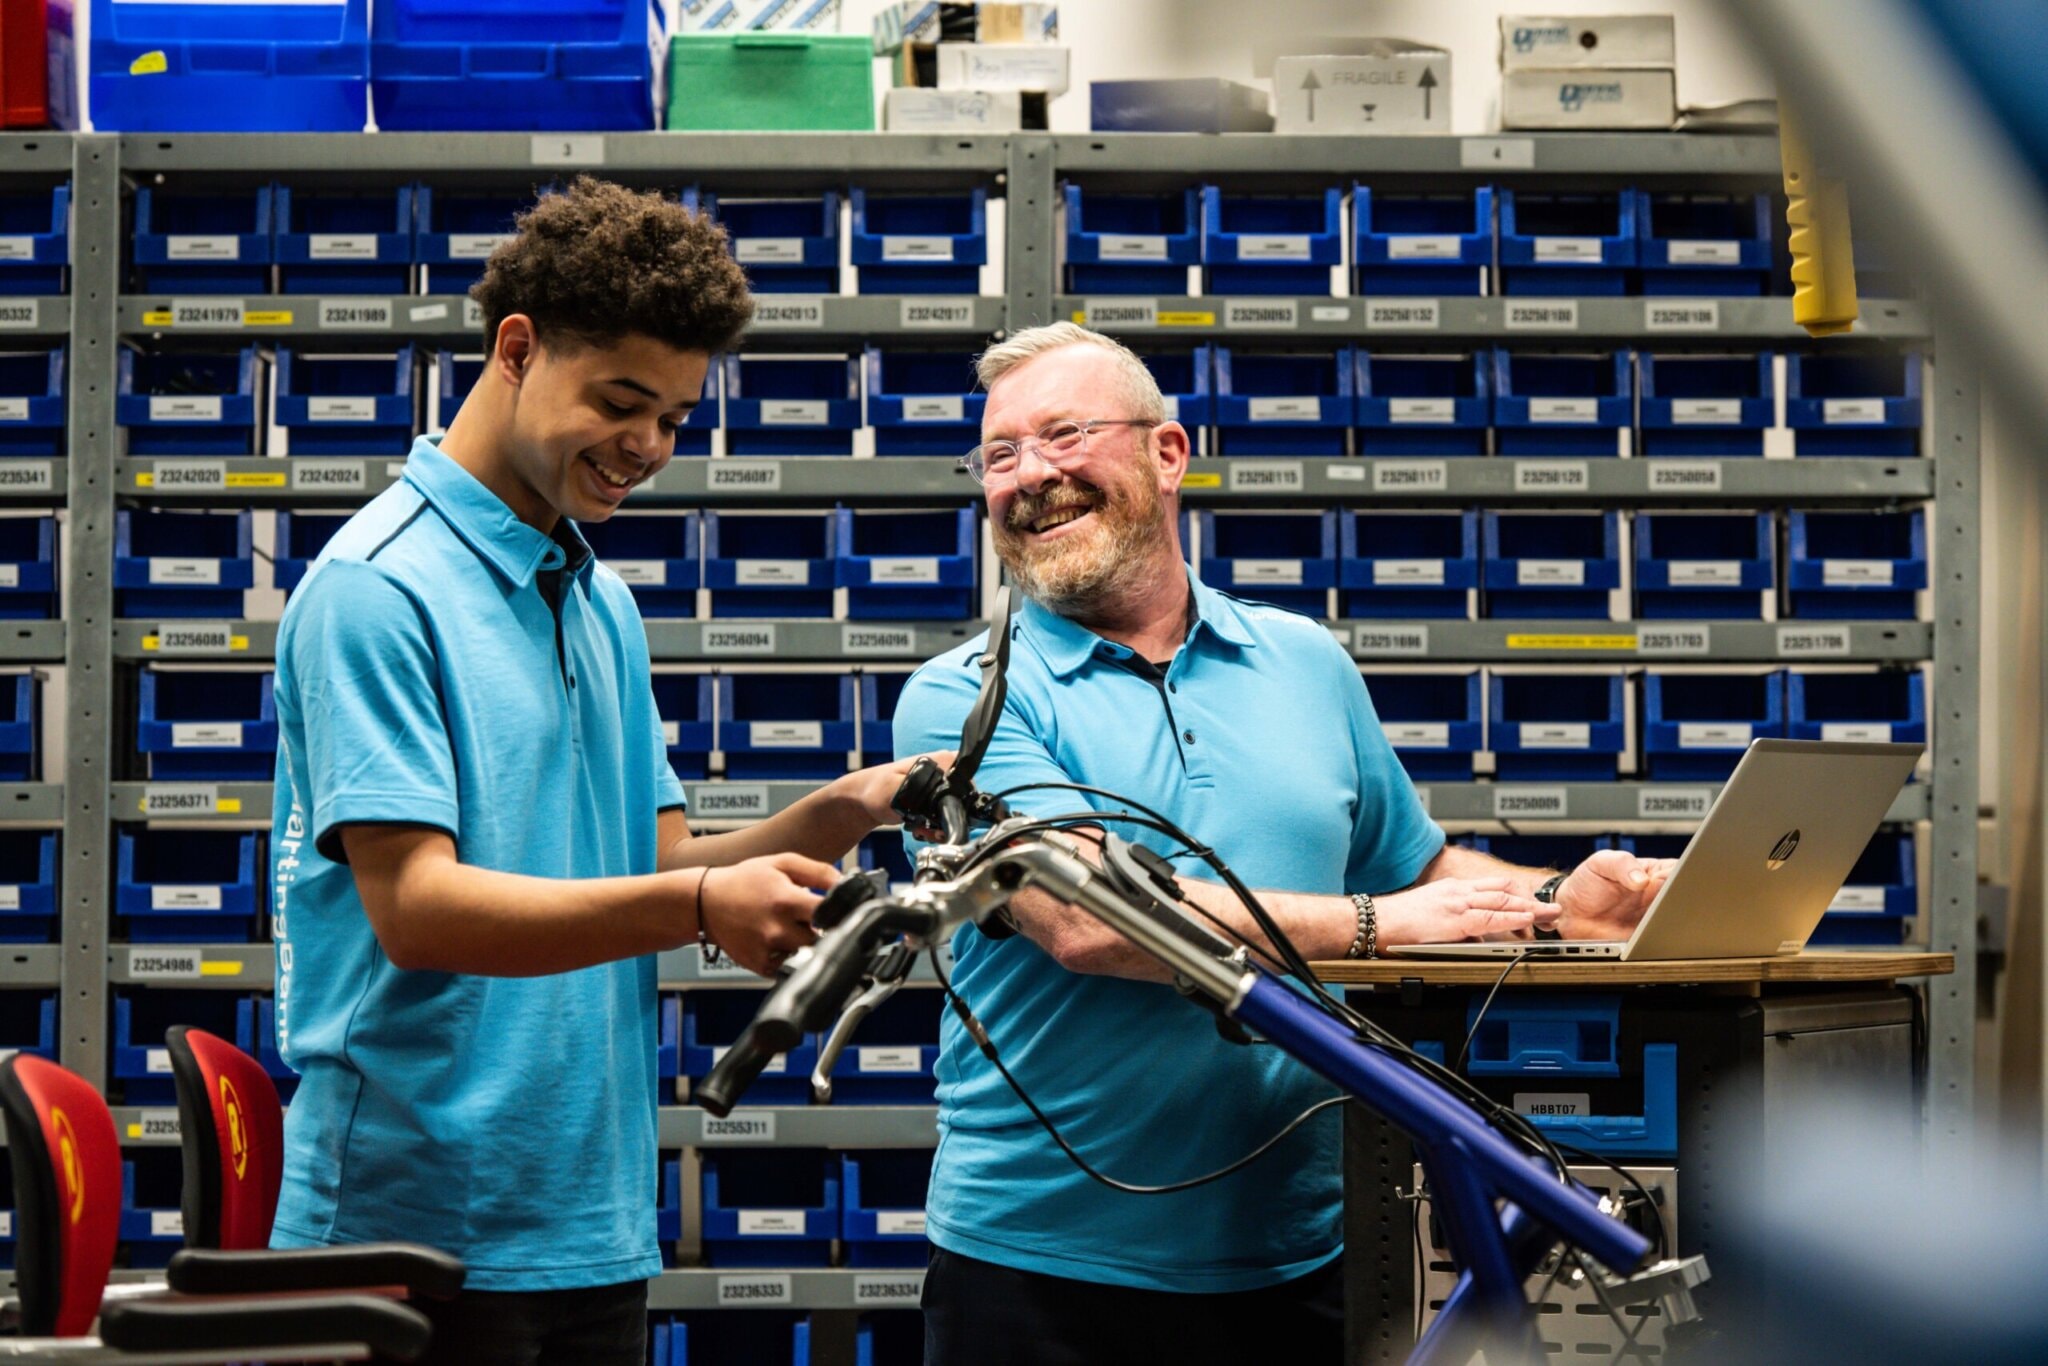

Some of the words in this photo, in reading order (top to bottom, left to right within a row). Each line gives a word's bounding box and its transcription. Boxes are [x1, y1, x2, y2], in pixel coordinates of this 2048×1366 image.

[1331, 71, 1406, 86] FRAGILE
[178, 307, 240, 323] 23241979
[325, 307, 387, 323] 23241989
[159, 468, 221, 484] 23242020
[299, 468, 361, 484] 23242024
[164, 632, 227, 647] 23256088
[708, 632, 770, 647] 23256094
[149, 793, 210, 809] 23256371
[272, 785, 305, 1056] artingBank
[133, 957, 195, 972] 23254986
[1530, 1103, 1578, 1116] HBBT07
[706, 1119, 767, 1136] 23255311
